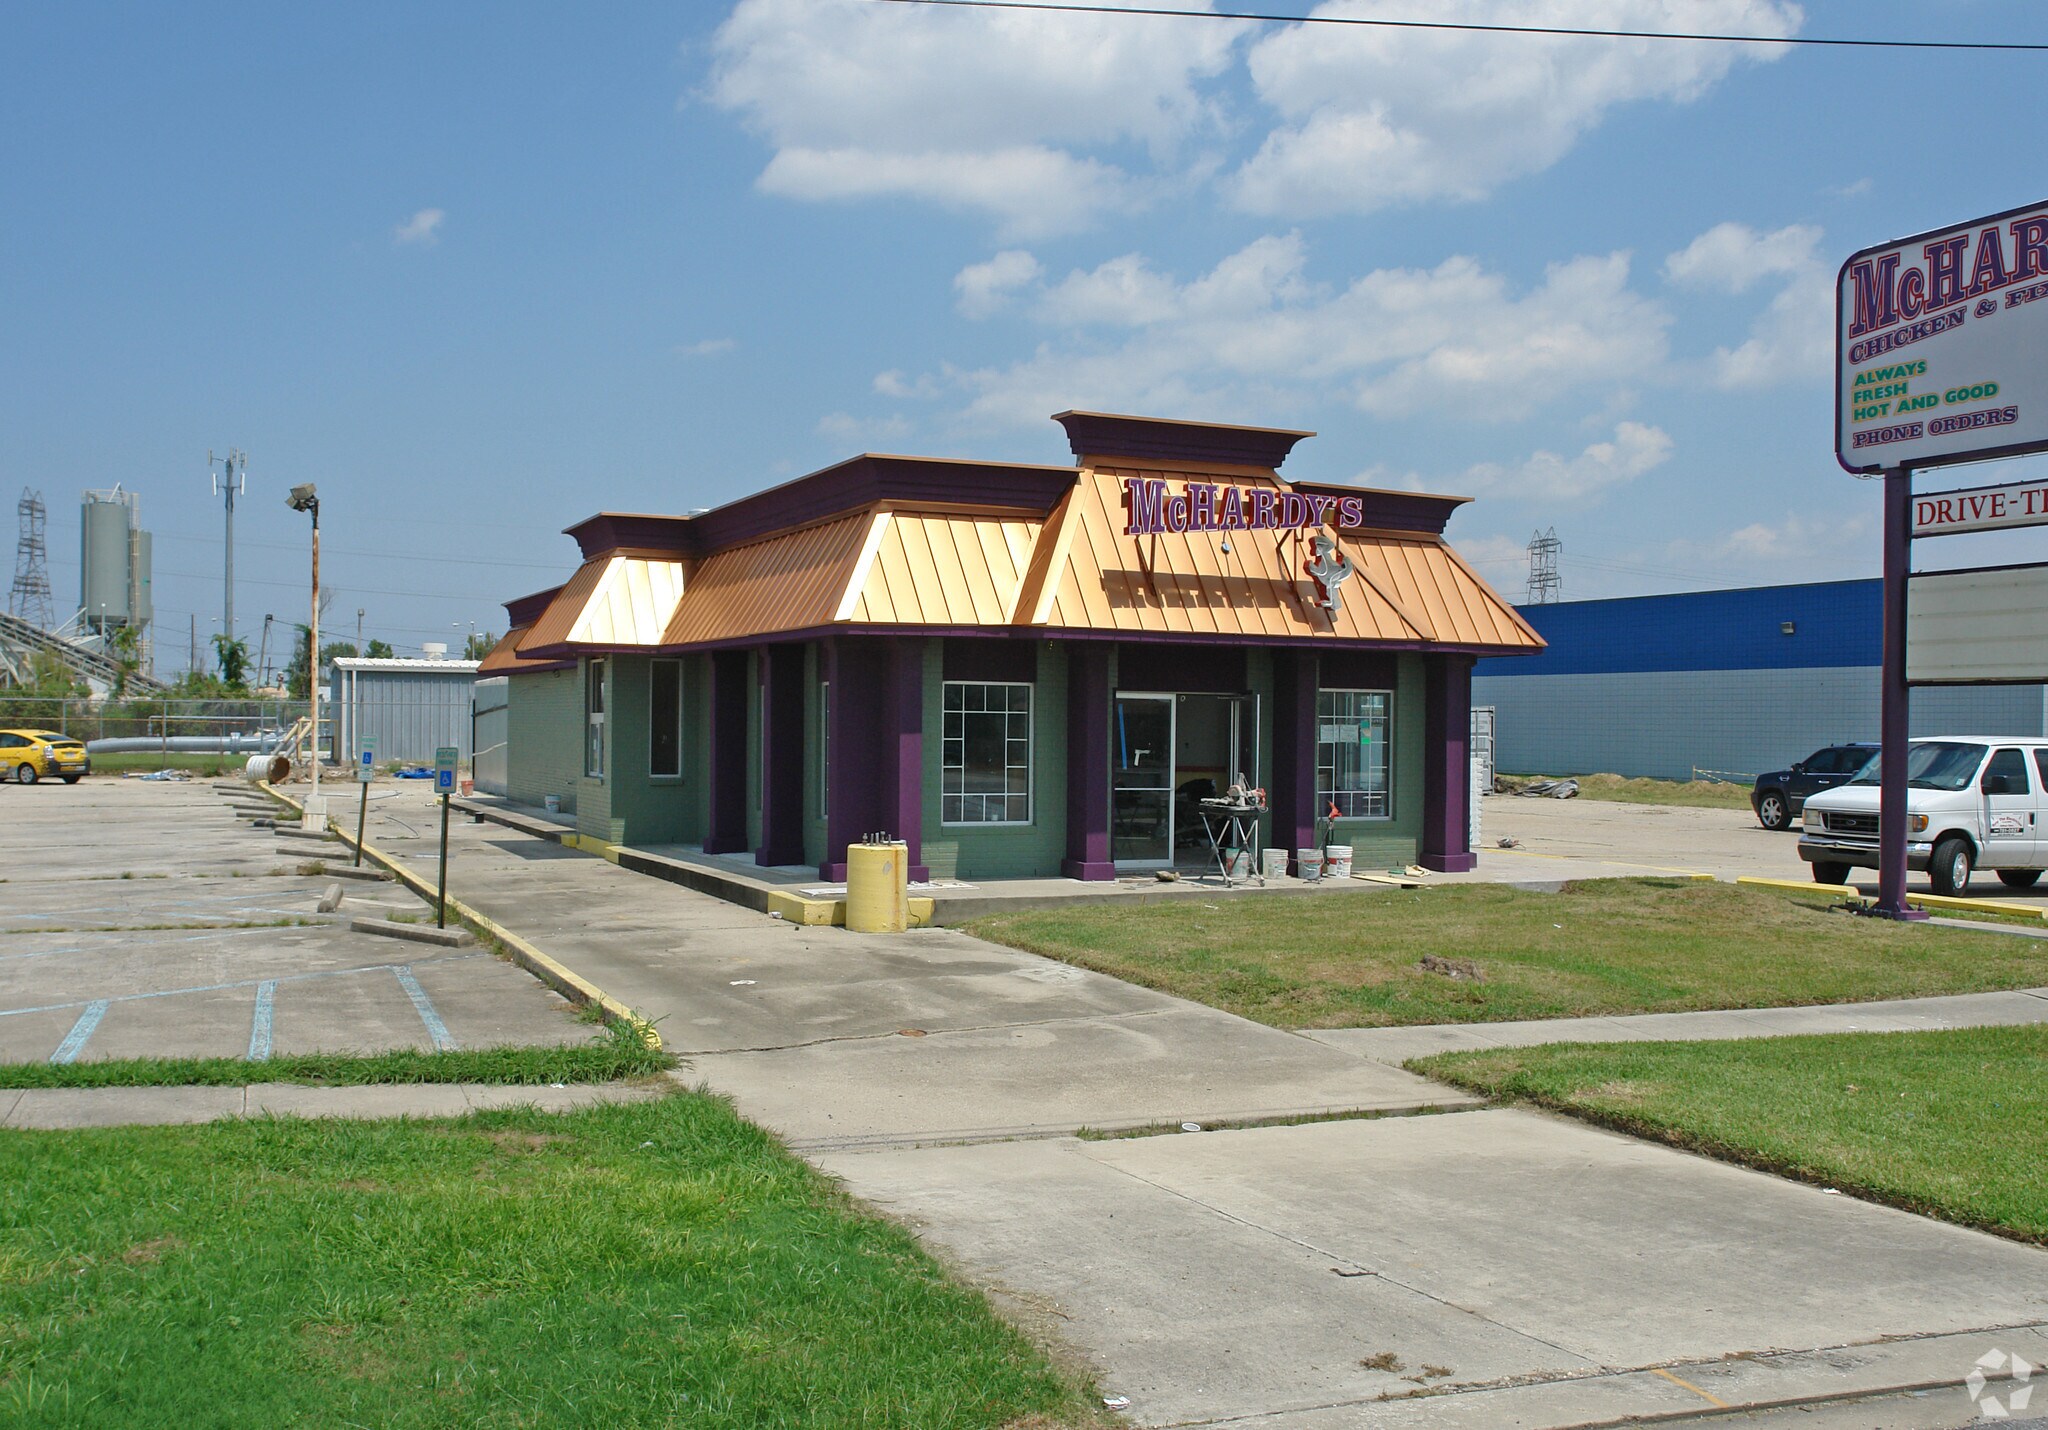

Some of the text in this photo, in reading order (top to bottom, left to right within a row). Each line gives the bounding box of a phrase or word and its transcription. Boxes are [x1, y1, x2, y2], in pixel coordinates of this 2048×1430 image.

[1848, 305, 1967, 365] CHICKEN
[1973, 299, 1997, 318] &
[1852, 382, 1908, 405] FRESH
[1853, 359, 1927, 387] ALWAYS
[1852, 381, 2000, 423] HOT AND GOOD
[1852, 405, 2018, 448] PHONE ORDERS
[1123, 477, 1363, 536] McHARDY'S
